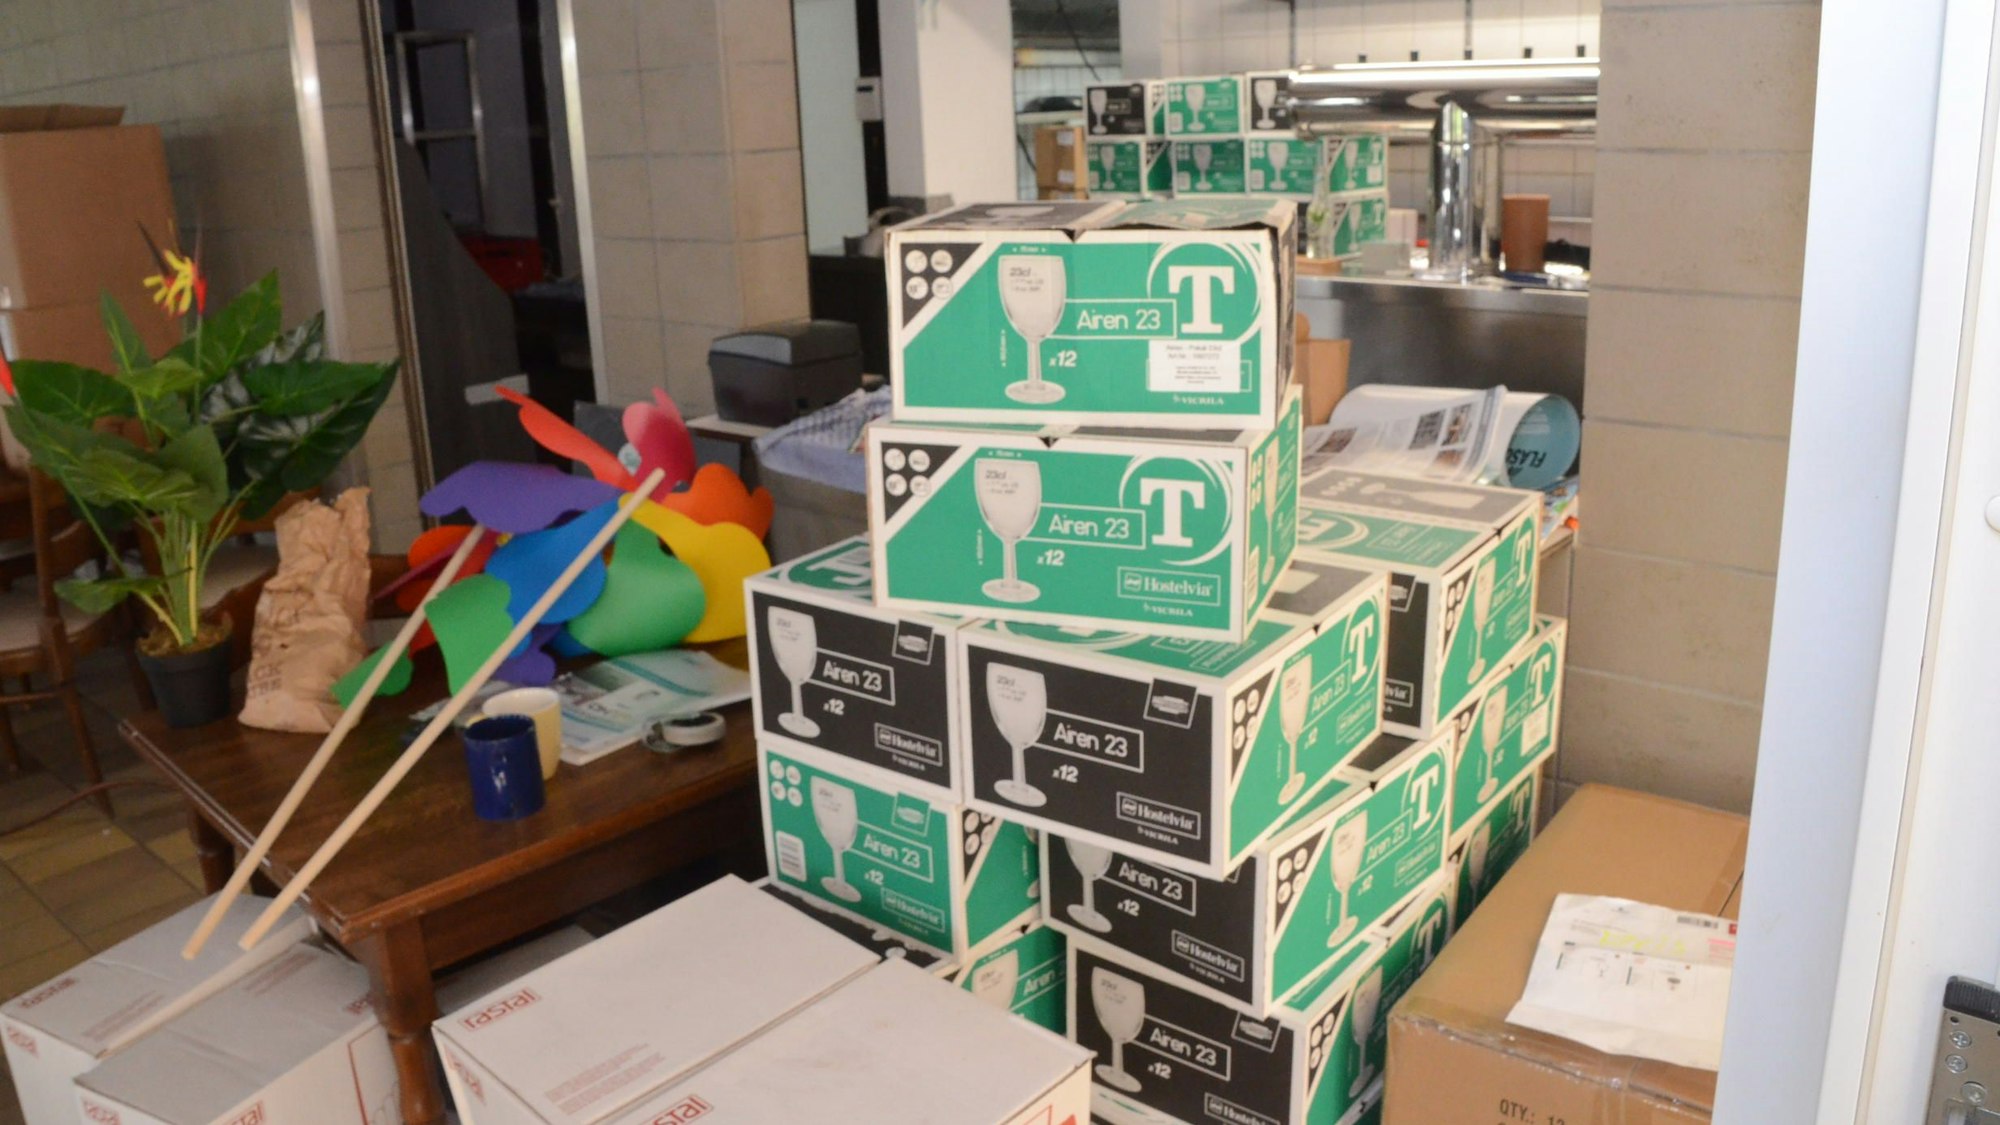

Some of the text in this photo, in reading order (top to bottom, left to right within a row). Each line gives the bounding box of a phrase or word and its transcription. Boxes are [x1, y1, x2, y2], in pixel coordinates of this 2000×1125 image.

[1168, 266, 1235, 334] T
[1077, 309, 1160, 330] Airen 23
[1049, 351, 1077, 368] x12
[1049, 515, 1130, 540] Airen 23
[1139, 478, 1205, 547] T
[1037, 550, 1065, 566] x12
[1144, 576, 1212, 597] Hostelvia
[1349, 613, 1374, 684] T
[823, 660, 882, 692] Airen 23
[1053, 723, 1128, 758] Airen 23
[1053, 765, 1079, 783] x12
[1411, 764, 1439, 830] T
[863, 833, 921, 869] Airen 23
[1118, 861, 1183, 901] Airen 23
[1118, 900, 1140, 917] x12
[464, 988, 537, 1030] rastal
[1150, 1027, 1217, 1067] Airen 23
[1148, 1062, 1171, 1079] x12
